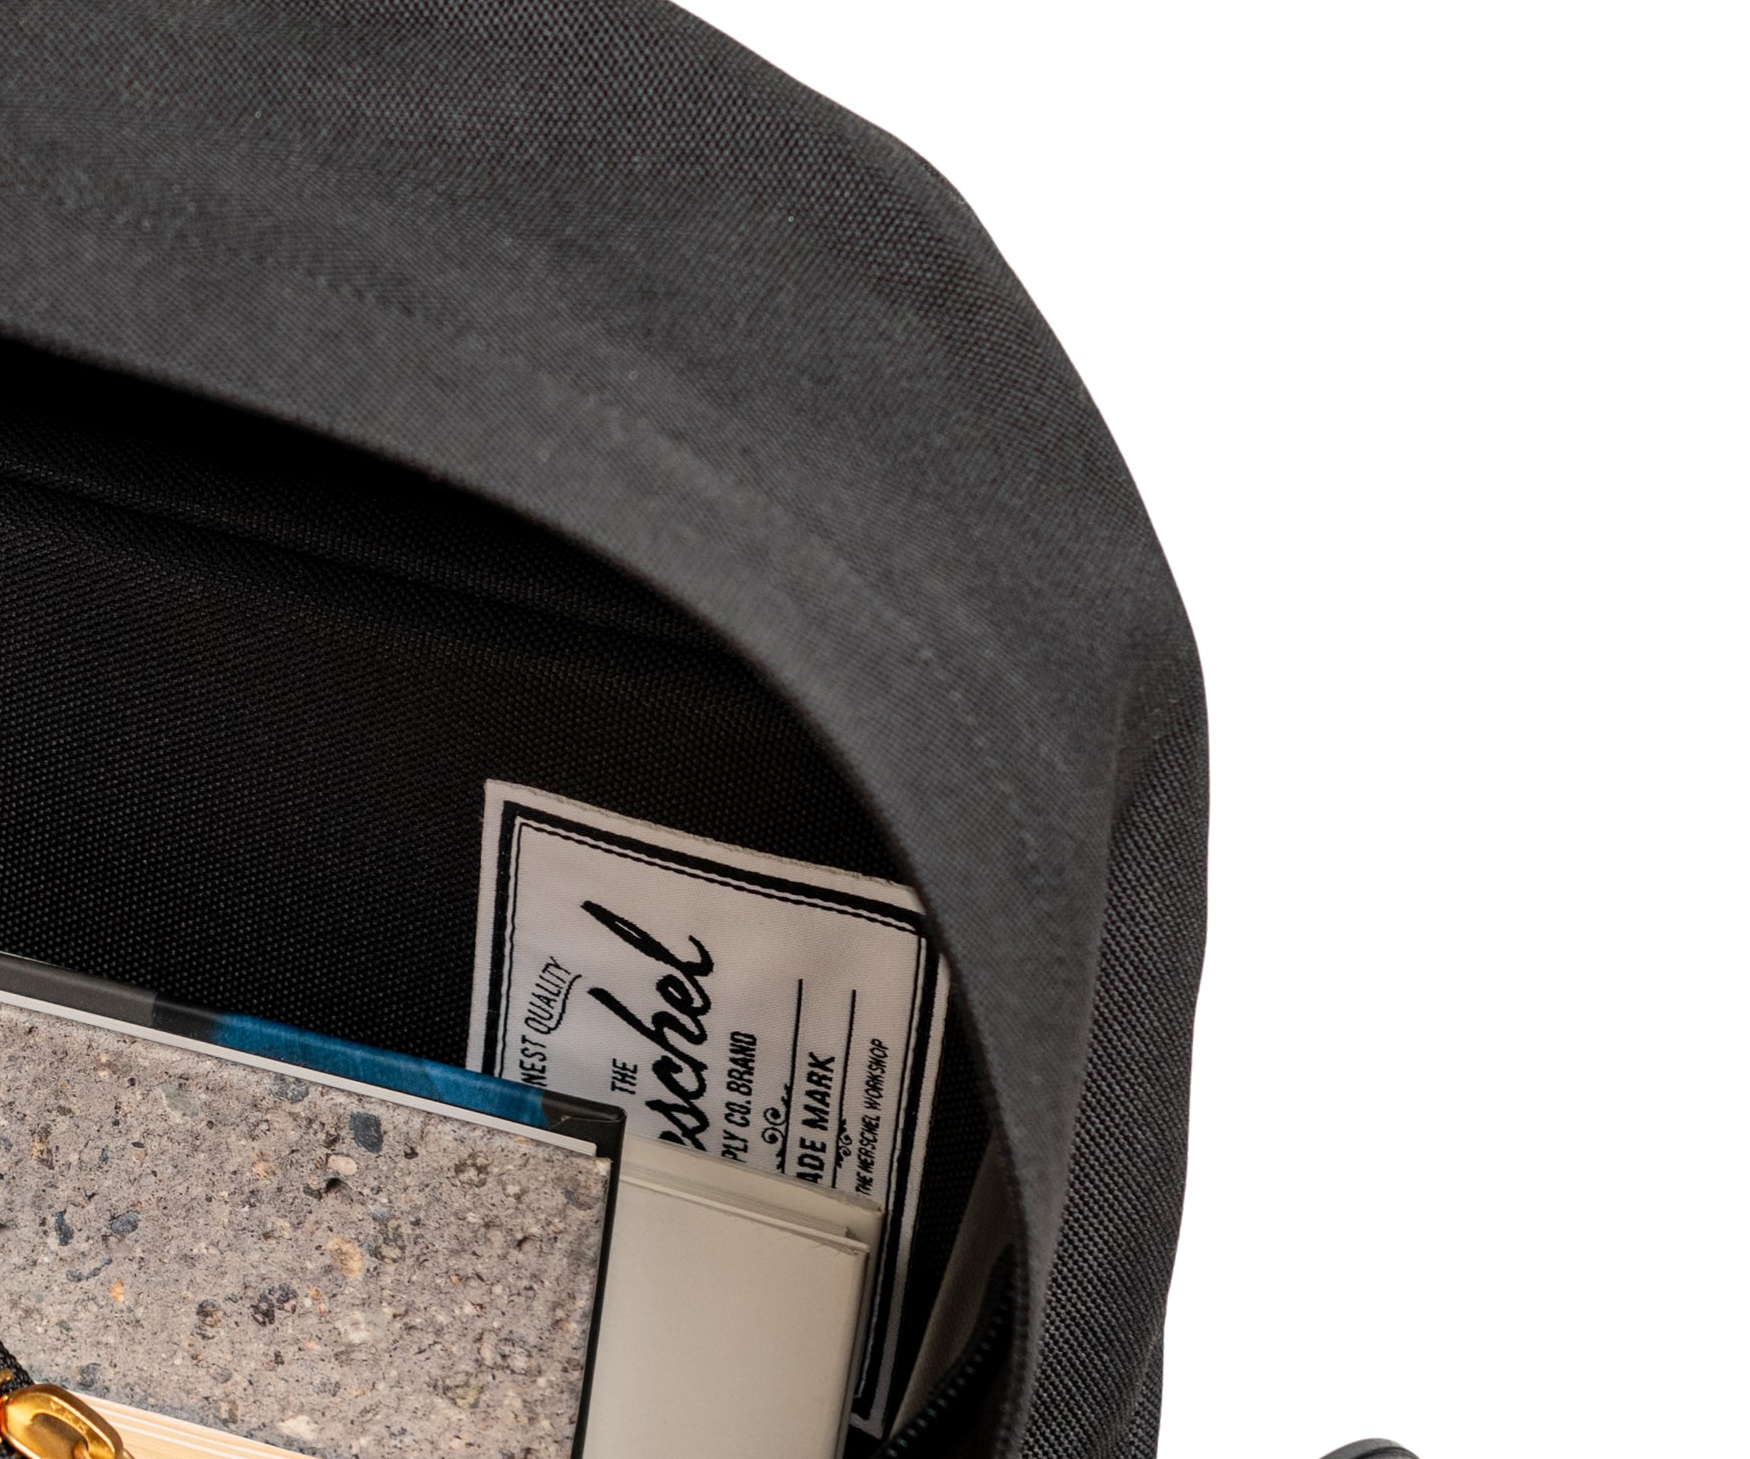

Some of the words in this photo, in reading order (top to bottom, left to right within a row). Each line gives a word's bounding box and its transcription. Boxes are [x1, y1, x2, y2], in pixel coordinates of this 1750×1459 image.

[525, 956, 581, 1034] QUALITY
[519, 1035, 550, 1087] NEST
[611, 1058, 639, 1095] THE
[727, 1031, 758, 1096] BRAND
[862, 1038, 890, 1111] WORKSHOP
[801, 1051, 836, 1129] MARK
[721, 1132, 750, 1163] PLY
[795, 1142, 827, 1184] ADE
[856, 1114, 882, 1173] HERSCHEL
[854, 1174, 874, 1196] THE
